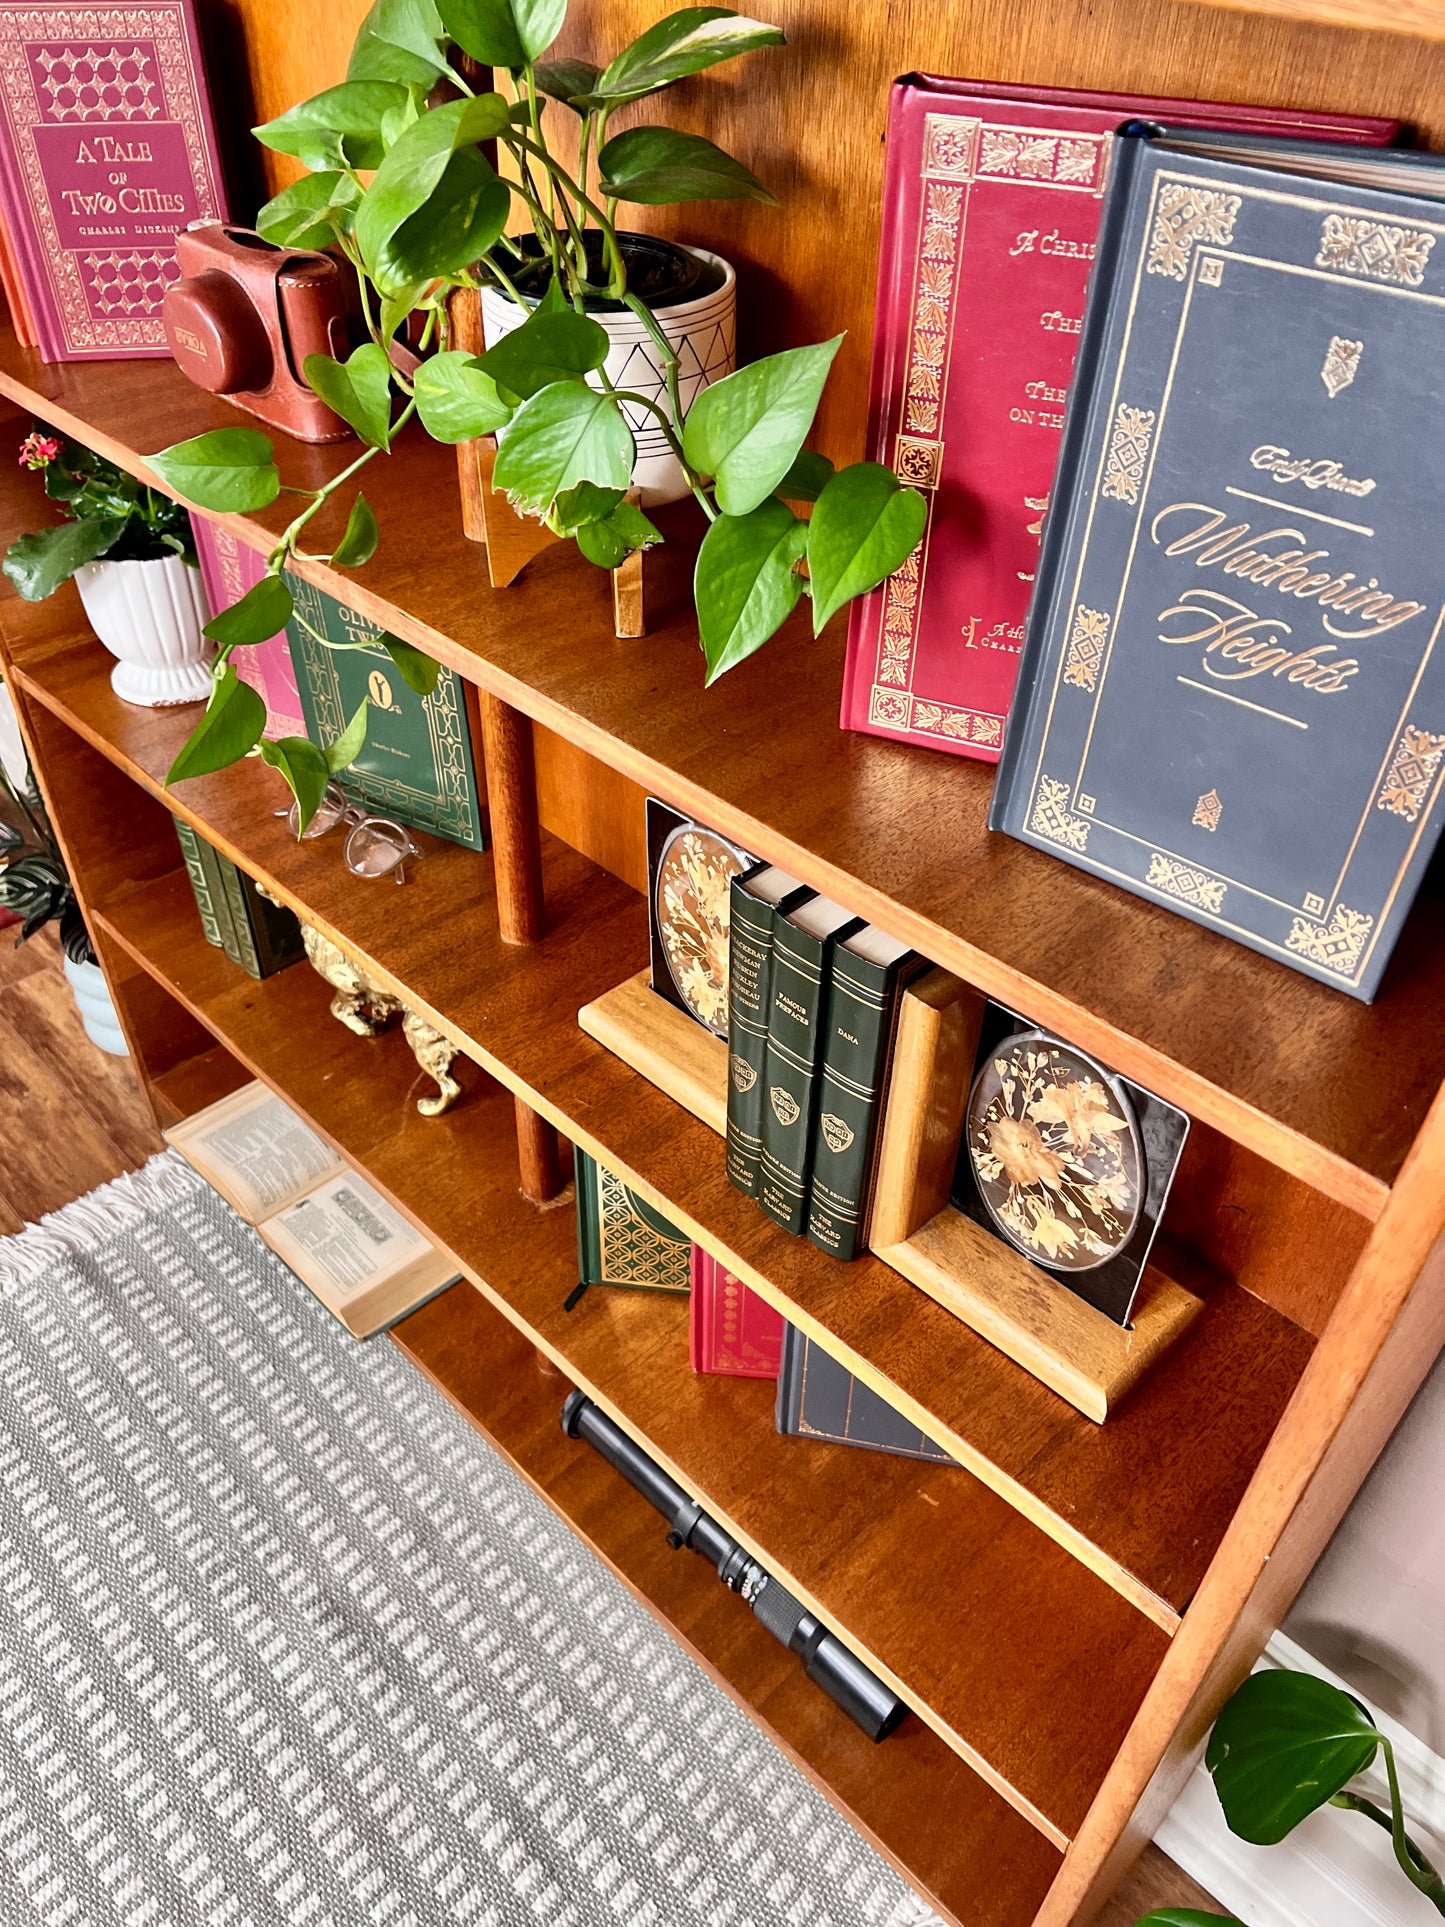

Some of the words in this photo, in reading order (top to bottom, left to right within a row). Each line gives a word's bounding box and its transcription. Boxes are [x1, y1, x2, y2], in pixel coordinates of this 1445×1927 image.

[76, 140, 97, 164] A
[94, 136, 153, 163] TALE
[62, 190, 117, 216] TWO
[1009, 230, 1039, 256] A
[1025, 381, 1067, 404] THE
[1009, 408, 1035, 425] ON
[1250, 444, 1311, 483] Emily
[1152, 502, 1427, 639] Wuthering
[1158, 589, 1360, 693] Heights
[731, 932, 767, 961] ACKERAY
[731, 977, 760, 1001] OREAU
[776, 998, 809, 1026] PREFACES
[779, 992, 806, 1015] FAMOUS
[837, 1027, 859, 1046] DANA
[763, 1188, 793, 1213] HARVARD
[763, 1197, 791, 1221] CLASSICS
[809, 1213, 841, 1240] HARVARD
[818, 1213, 832, 1227] THE
[809, 1224, 839, 1248] CLASSICS
